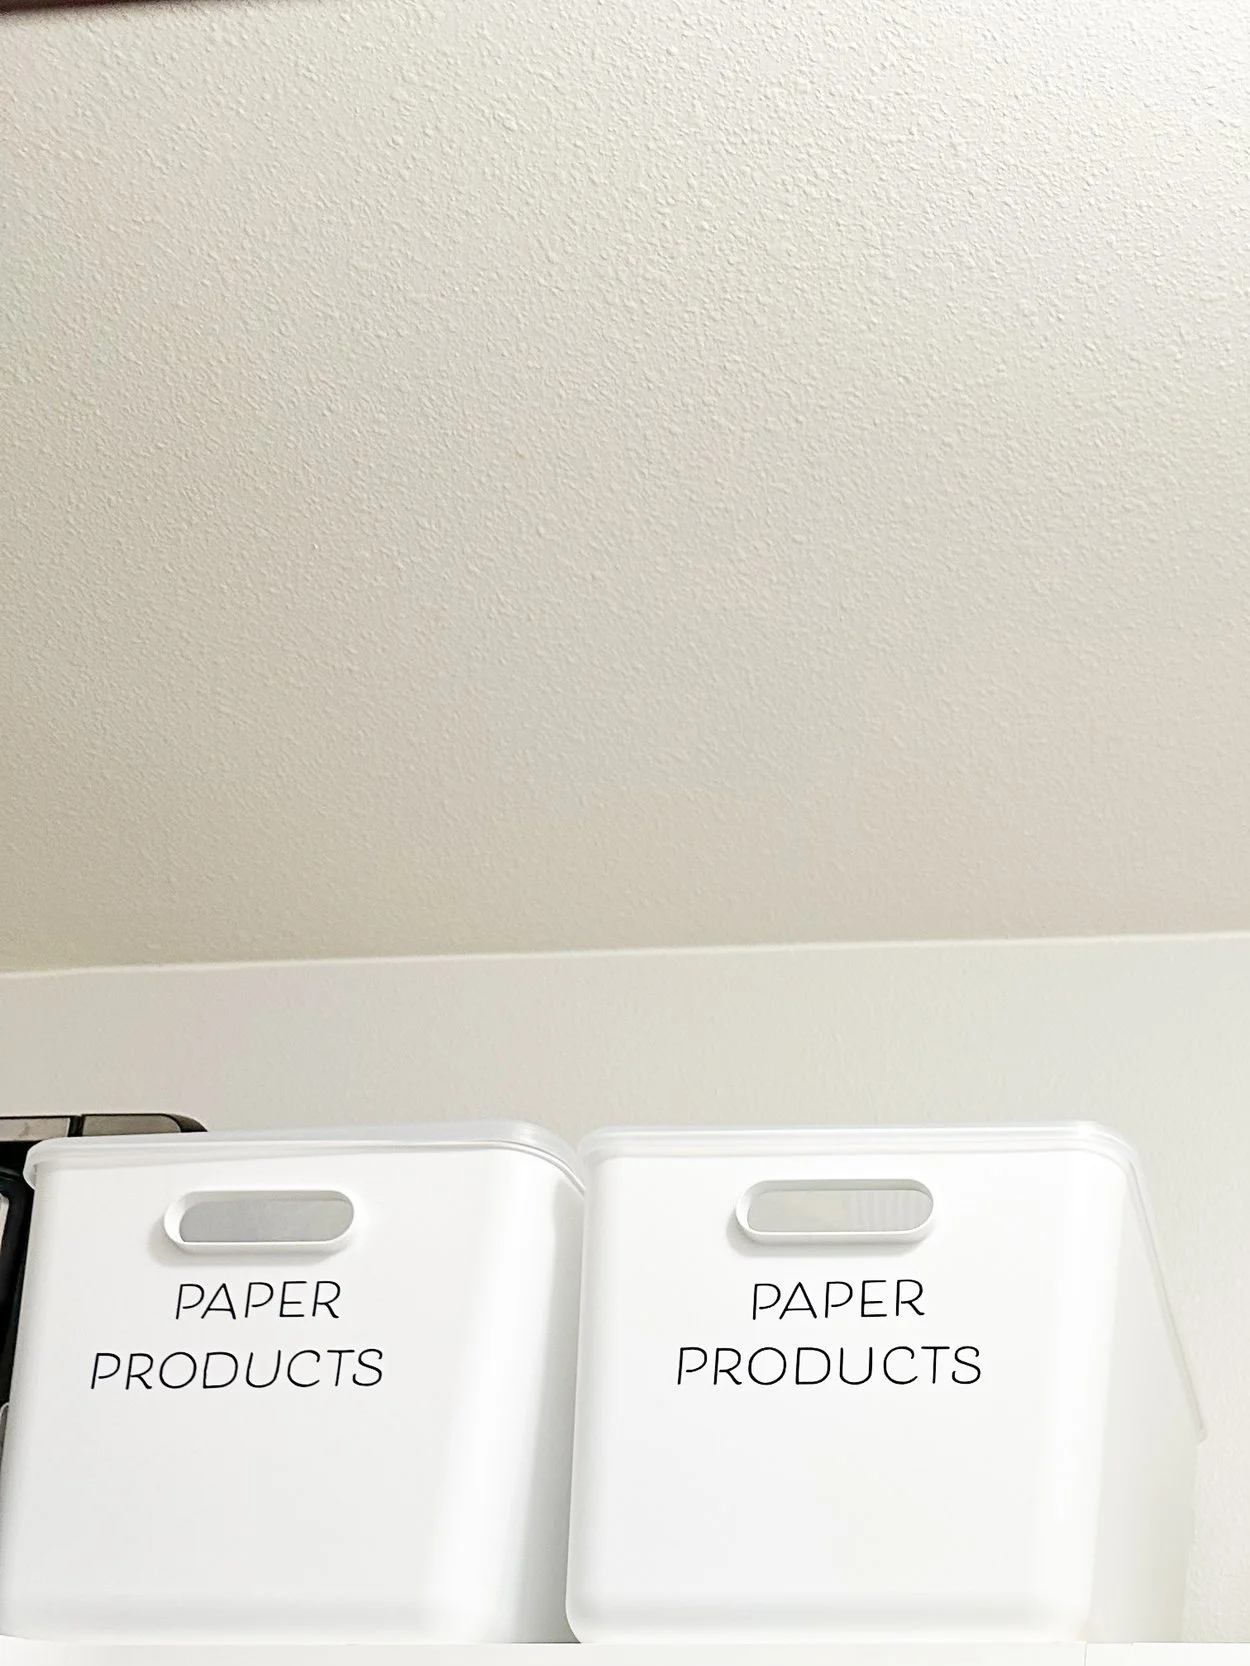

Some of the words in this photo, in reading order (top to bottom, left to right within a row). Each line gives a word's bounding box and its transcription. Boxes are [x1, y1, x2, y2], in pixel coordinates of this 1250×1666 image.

[175, 1280, 341, 1321] PAPER
[752, 1278, 926, 1321] PAPER
[90, 1348, 384, 1391] PRODUCTS
[676, 1345, 982, 1387] PRODUCTS
